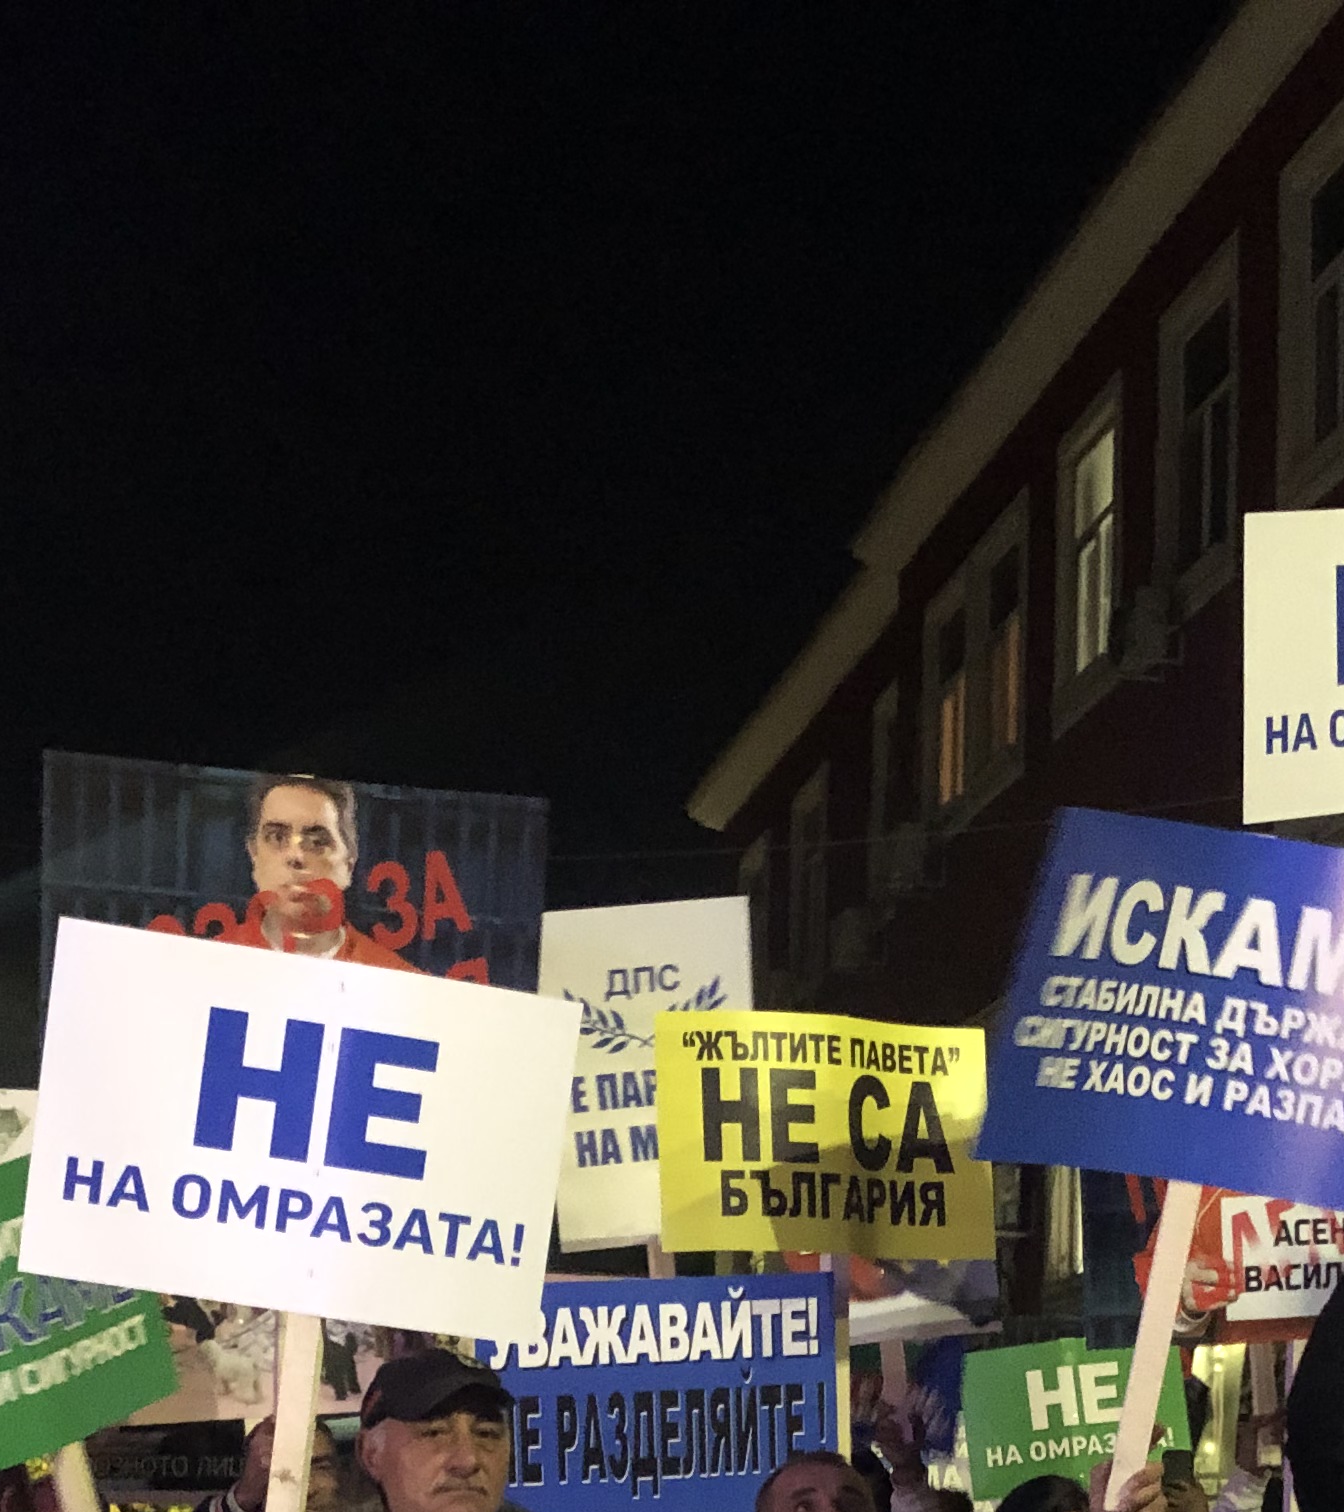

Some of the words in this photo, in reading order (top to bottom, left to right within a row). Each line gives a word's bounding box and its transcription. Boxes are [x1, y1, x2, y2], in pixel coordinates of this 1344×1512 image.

[1265, 713, 1317, 755] НА
[366, 850, 473, 950] ЗА
[604, 963, 681, 1000] ДПС
[1040, 974, 1208, 1027] СТАБИЛНА
[1014, 1015, 1200, 1066] СИГУРНОСТ
[1205, 1036, 1255, 1077] ЗА
[193, 1006, 440, 1180] НЕ
[571, 1075, 590, 1113] Е
[595, 1069, 657, 1111] ПАР
[1035, 1055, 1082, 1090] НЕ
[1082, 1058, 1176, 1102] ХАОС
[1184, 1071, 1216, 1108] И
[574, 1127, 623, 1168] НА
[629, 1123, 660, 1163] М
[701, 1067, 821, 1163] НЕ
[848, 1075, 956, 1175] СА
[62, 1156, 149, 1213] НА
[172, 1173, 525, 1267] ОМРАЗАТА!
[721, 1169, 947, 1227] БЪЛГАРИЯ
[1025, 1361, 1125, 1432] НЕ
[985, 1444, 1024, 1468] НА
[1029, 1427, 1175, 1463] ОМРАЗ!
